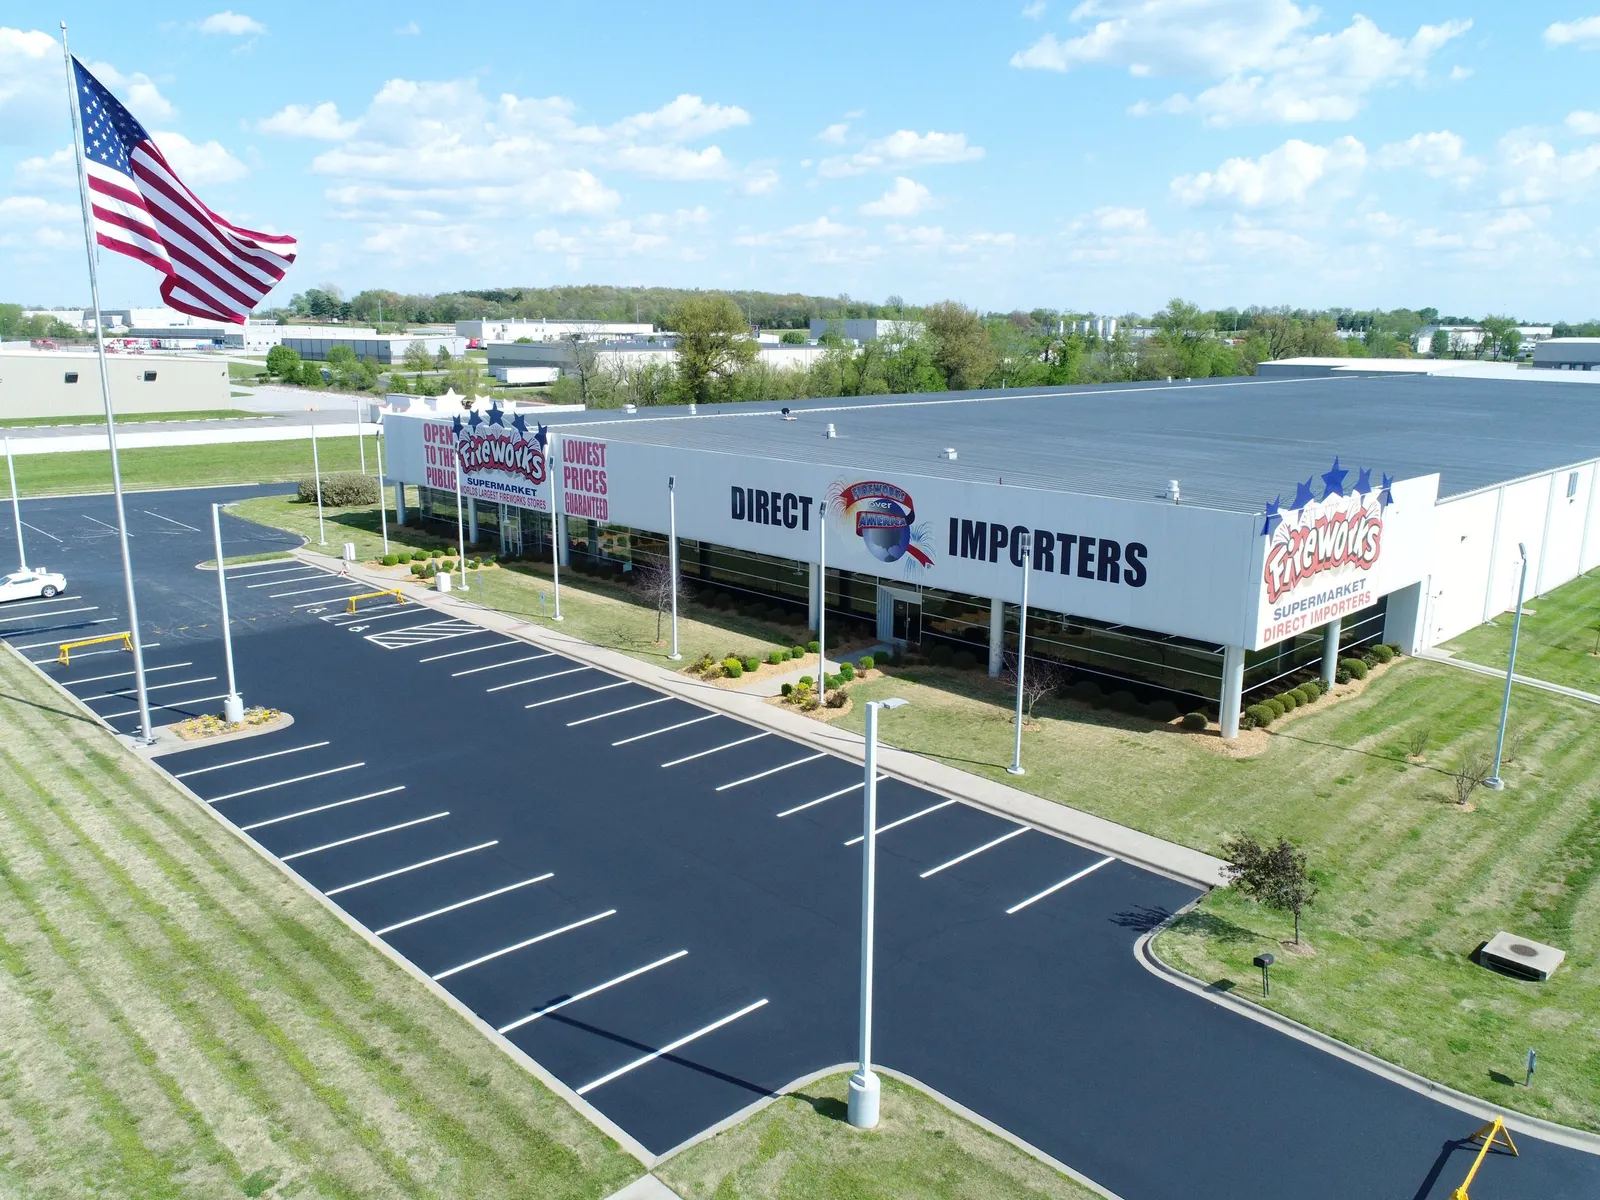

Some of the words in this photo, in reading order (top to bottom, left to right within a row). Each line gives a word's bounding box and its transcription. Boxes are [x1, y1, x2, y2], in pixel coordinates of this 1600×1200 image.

[424, 423, 453, 445] OPEN
[424, 445, 436, 465] TO
[438, 447, 455, 468] THE
[562, 439, 606, 467] LOWEST
[426, 466, 456, 491] PUBLIC
[467, 477, 537, 497] SUPERMARKET
[564, 466, 607, 495] PRICES
[479, 488, 498, 500] LARGEST
[499, 492, 527, 507] FIREWORKS
[527, 497, 546, 510] STORES
[850, 483, 906, 502] FIREWORKS
[868, 501, 892, 509] over
[565, 492, 608, 521] GUARANTEED
[731, 486, 813, 531] DIRECT
[858, 512, 908, 528] AMERICA
[949, 517, 1149, 588] IMPORTERS
[1273, 578, 1367, 621] SUPERMARKET
[1263, 615, 1307, 643] DIRECT
[1310, 591, 1371, 625] IMPORTERS
